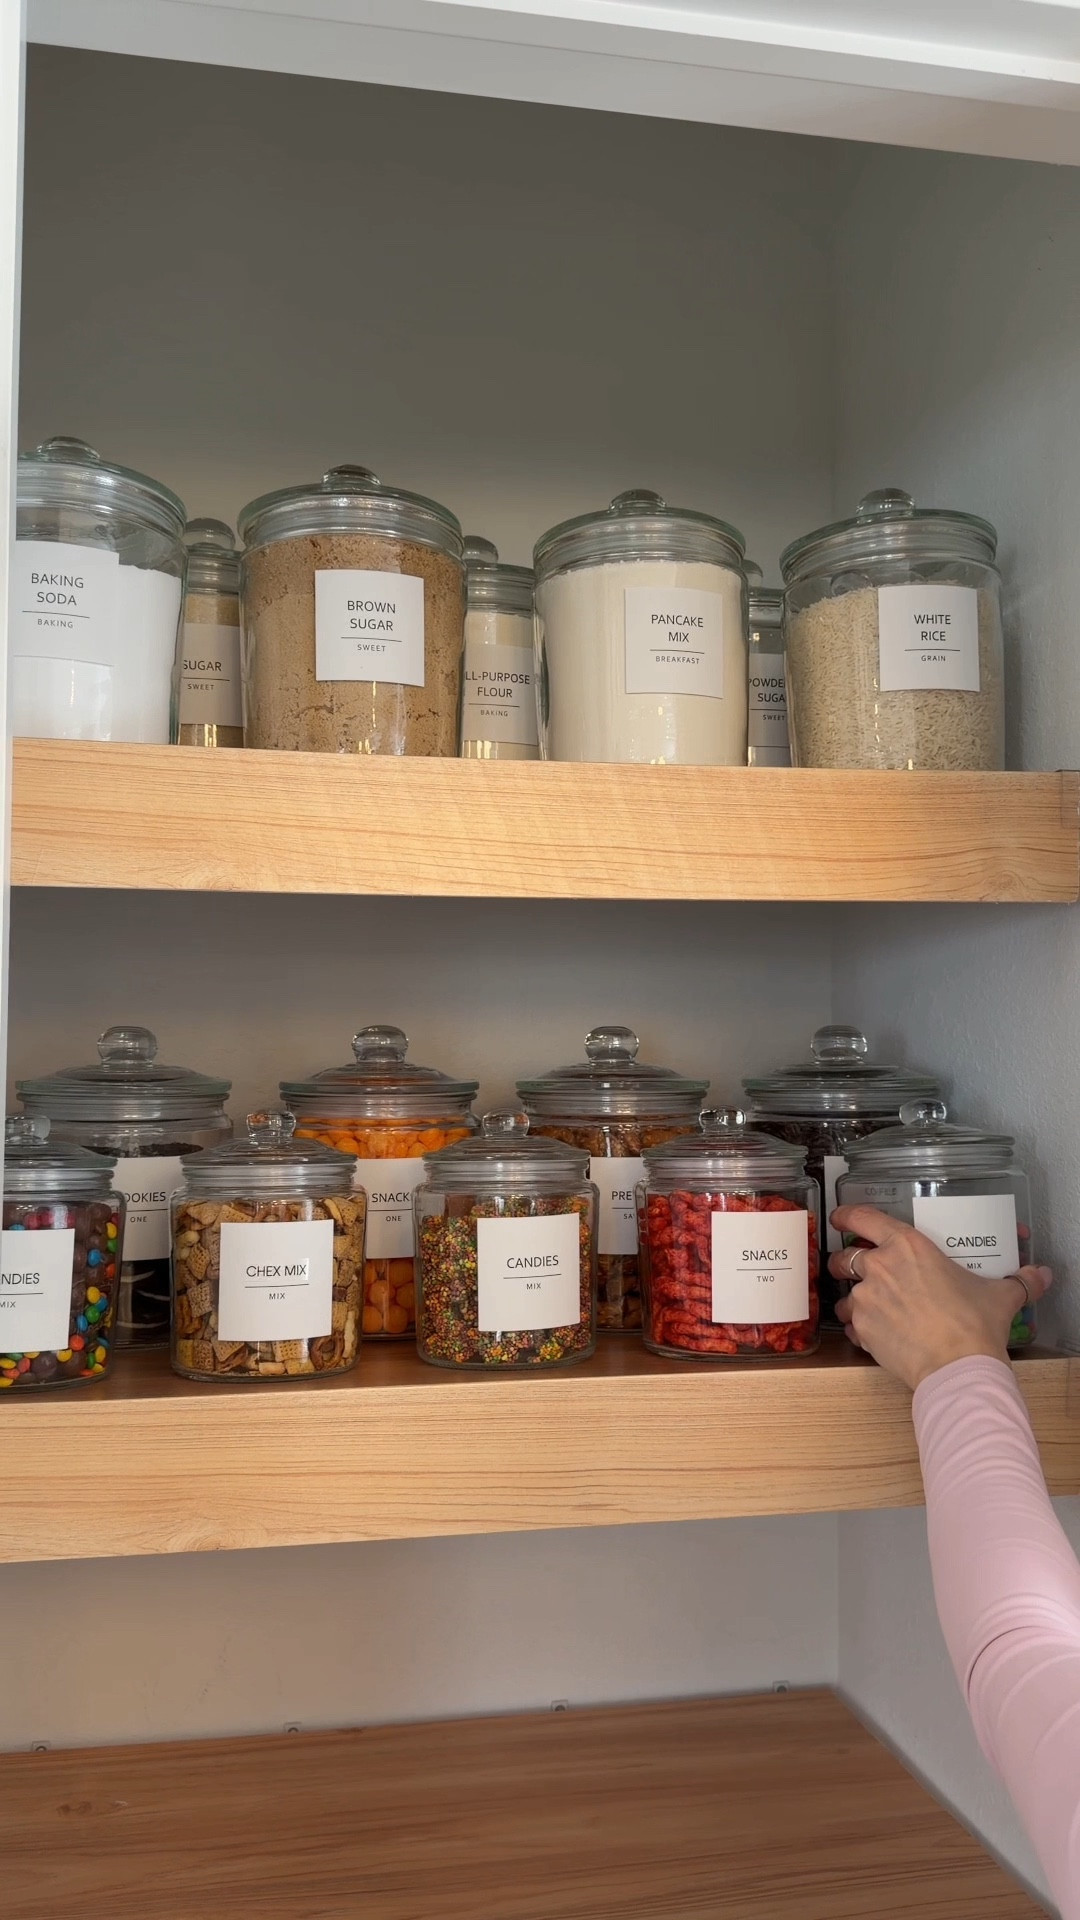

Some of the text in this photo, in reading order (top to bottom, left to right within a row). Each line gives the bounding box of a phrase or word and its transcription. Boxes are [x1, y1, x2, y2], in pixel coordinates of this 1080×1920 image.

[31, 572, 84, 589] BAKING
[36, 591, 77, 606] SODA
[347, 600, 396, 614] BROWN
[37, 618, 74, 629] BAKING
[349, 617, 394, 632] SUGAR
[651, 614, 704, 628] PANCAKE
[913, 614, 952, 625] WHITE
[668, 631, 690, 643] MIX
[920, 630, 947, 642] RICE
[357, 644, 386, 652] SWEET
[655, 655, 700, 665] BREAKFAST
[465, 671, 531, 685] LL-PURPOSE
[187, 683, 215, 691] SWEET
[477, 686, 513, 699] FLOUR
[757, 692, 786, 703] SUGA
[480, 709, 509, 717] BAKING
[125, 1191, 166, 1203] OOKIES
[371, 1191, 410, 1203] SNACK
[946, 1236, 997, 1248] CANDIES
[742, 1249, 788, 1261] SNACKS
[506, 1254, 559, 1269] CANDIES
[246, 1264, 307, 1277] CHEX MIX
[1, 1272, 40, 1285] NDIES
[526, 1282, 542, 1290] MIX
[268, 1292, 286, 1300] MIX
